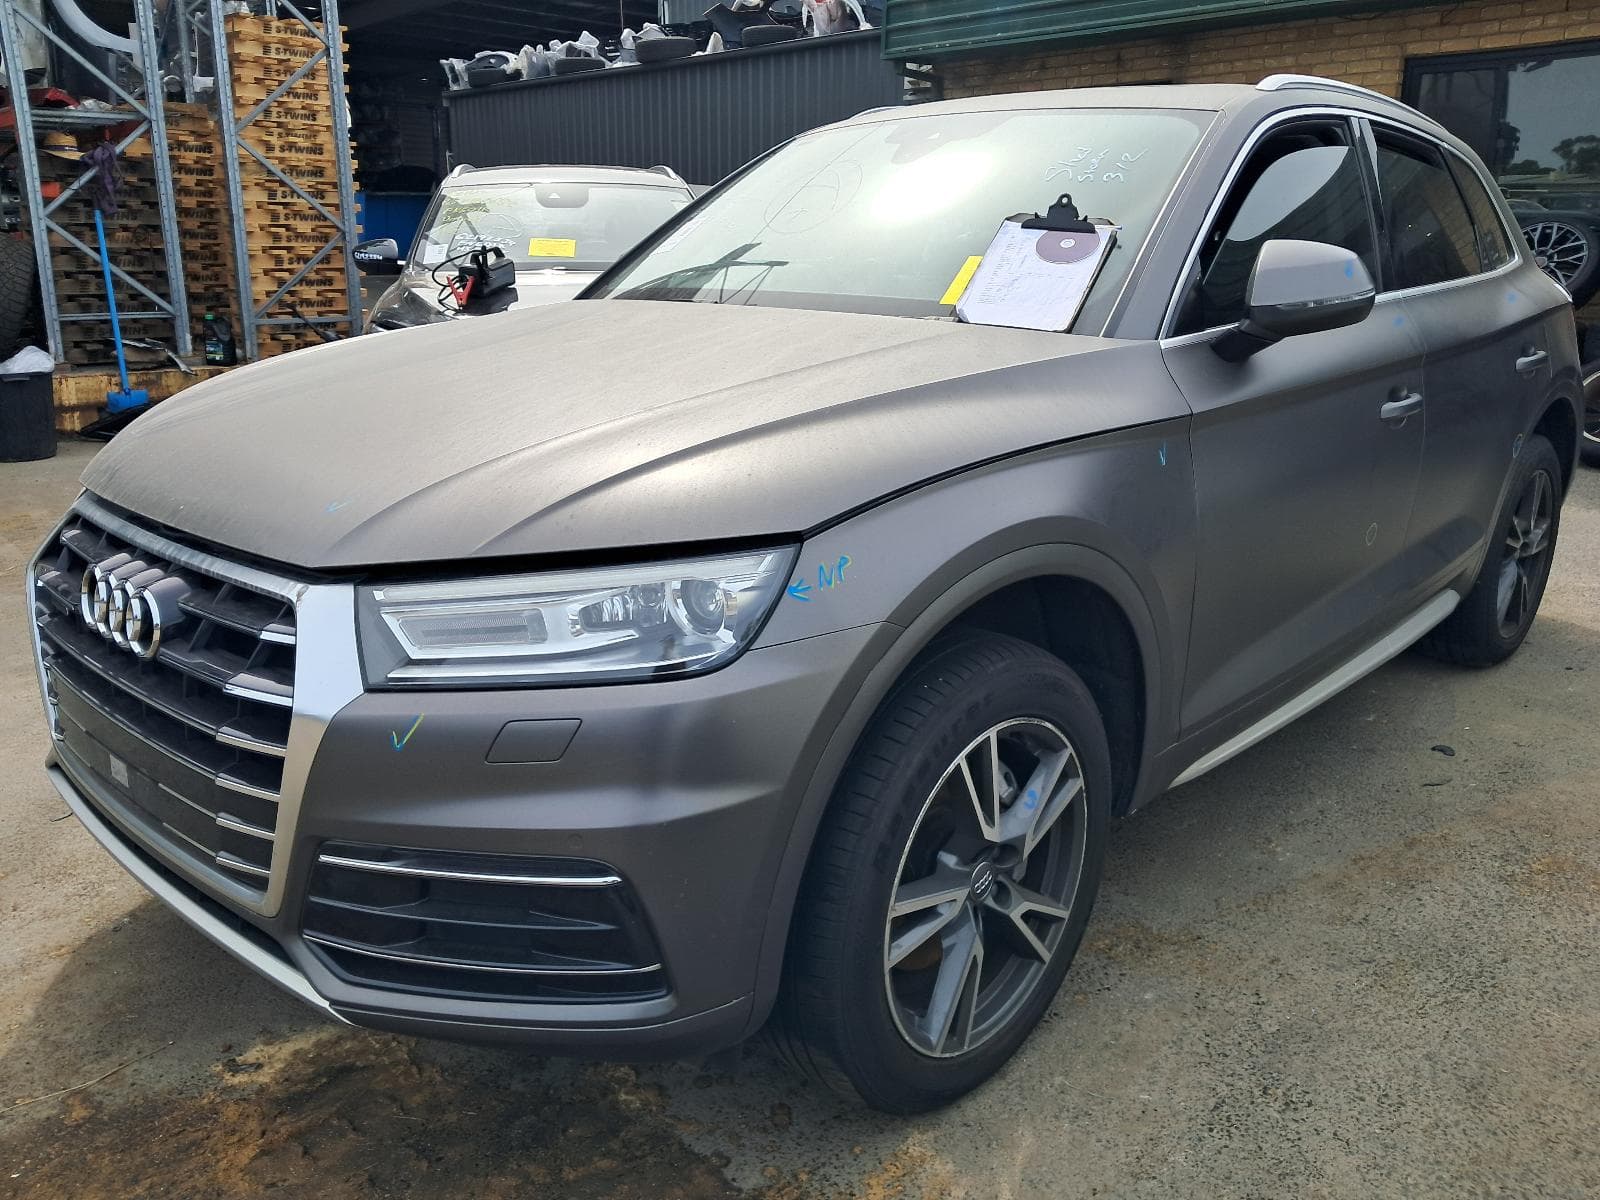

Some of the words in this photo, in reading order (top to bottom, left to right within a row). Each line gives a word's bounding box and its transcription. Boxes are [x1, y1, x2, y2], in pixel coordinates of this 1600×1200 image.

[275, 69, 316, 80] S-TNS
[280, 90, 319, 101] -TWINS
[275, 110, 317, 121] S-TWINS
[279, 144, 324, 155] S-TWINS
[172, 166, 214, 176] -TWINS
[818, 555, 852, 591] NP
